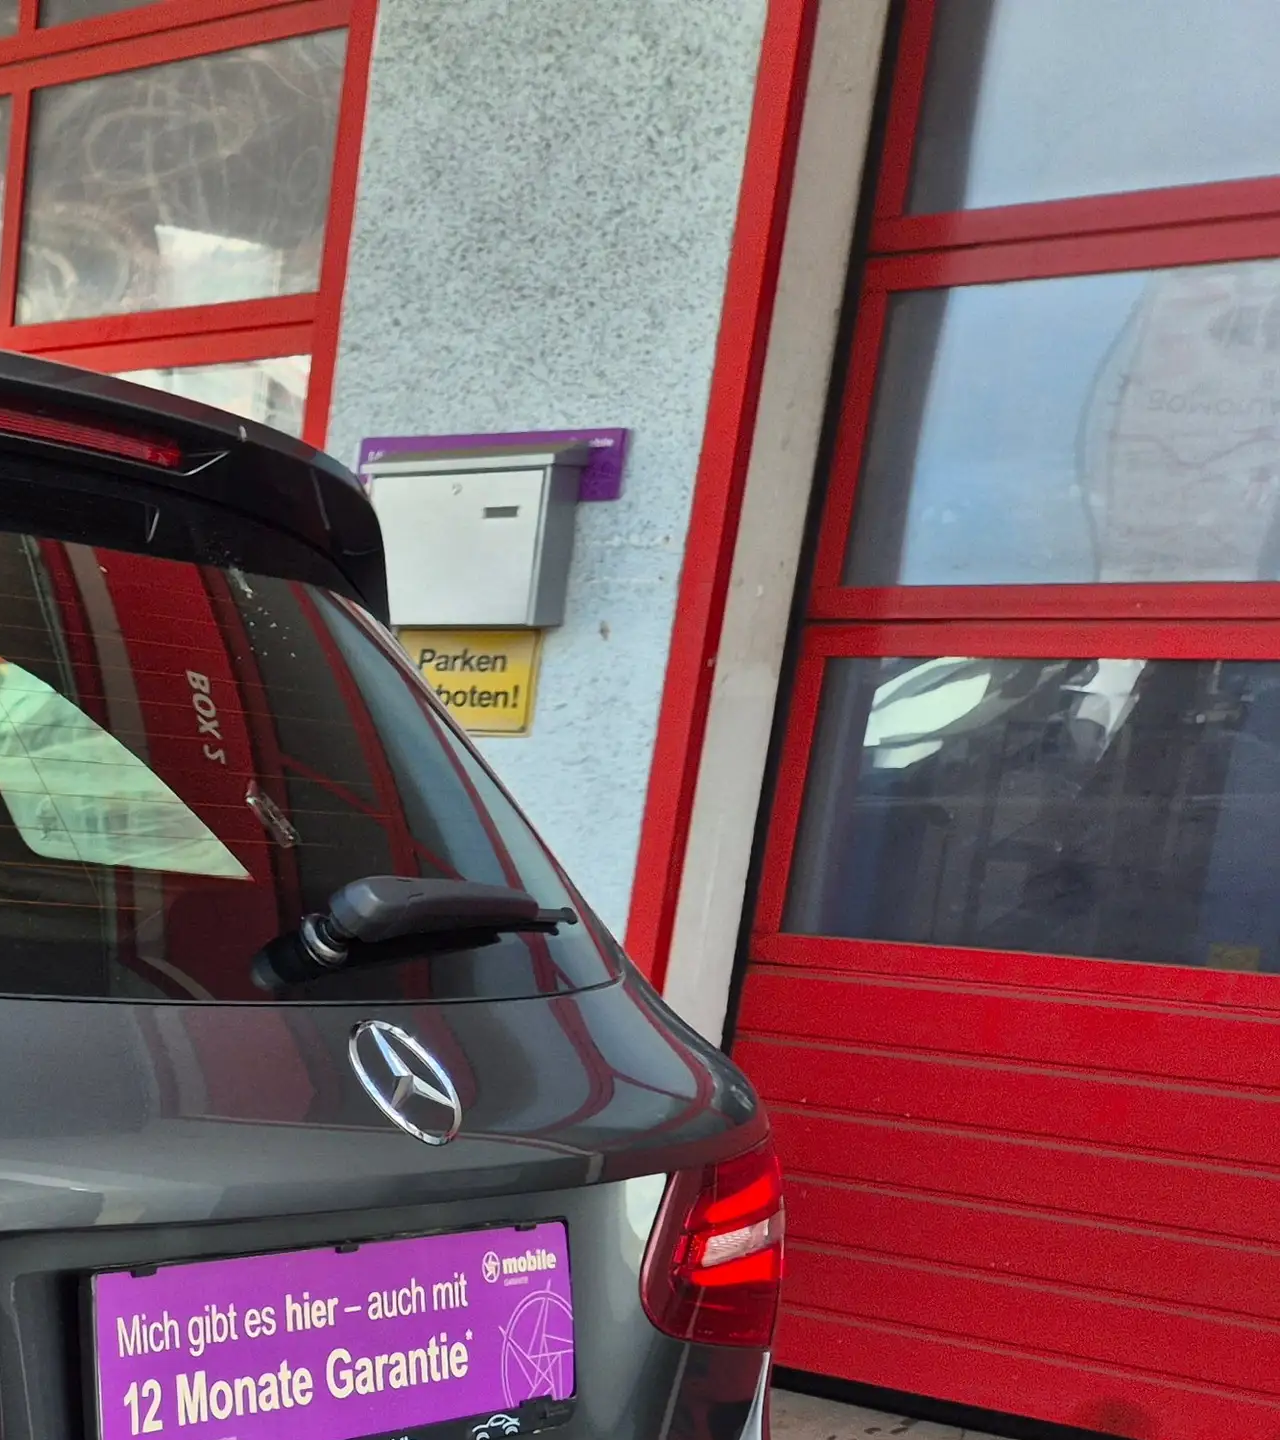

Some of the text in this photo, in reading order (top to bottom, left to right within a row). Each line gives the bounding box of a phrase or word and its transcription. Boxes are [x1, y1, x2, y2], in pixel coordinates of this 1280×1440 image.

[418, 647, 507, 673] Parken
[436, 684, 519, 709] boten!
[502, 1249, 557, 1274] mobile
[116, 1311, 180, 1357] Mich
[187, 1303, 238, 1357] gibt
[244, 1307, 277, 1338] es
[285, 1292, 339, 1332] hier
[368, 1278, 426, 1320] auch
[433, 1272, 468, 1311] mit
[123, 1379, 163, 1435] 12
[176, 1359, 313, 1426] Monate
